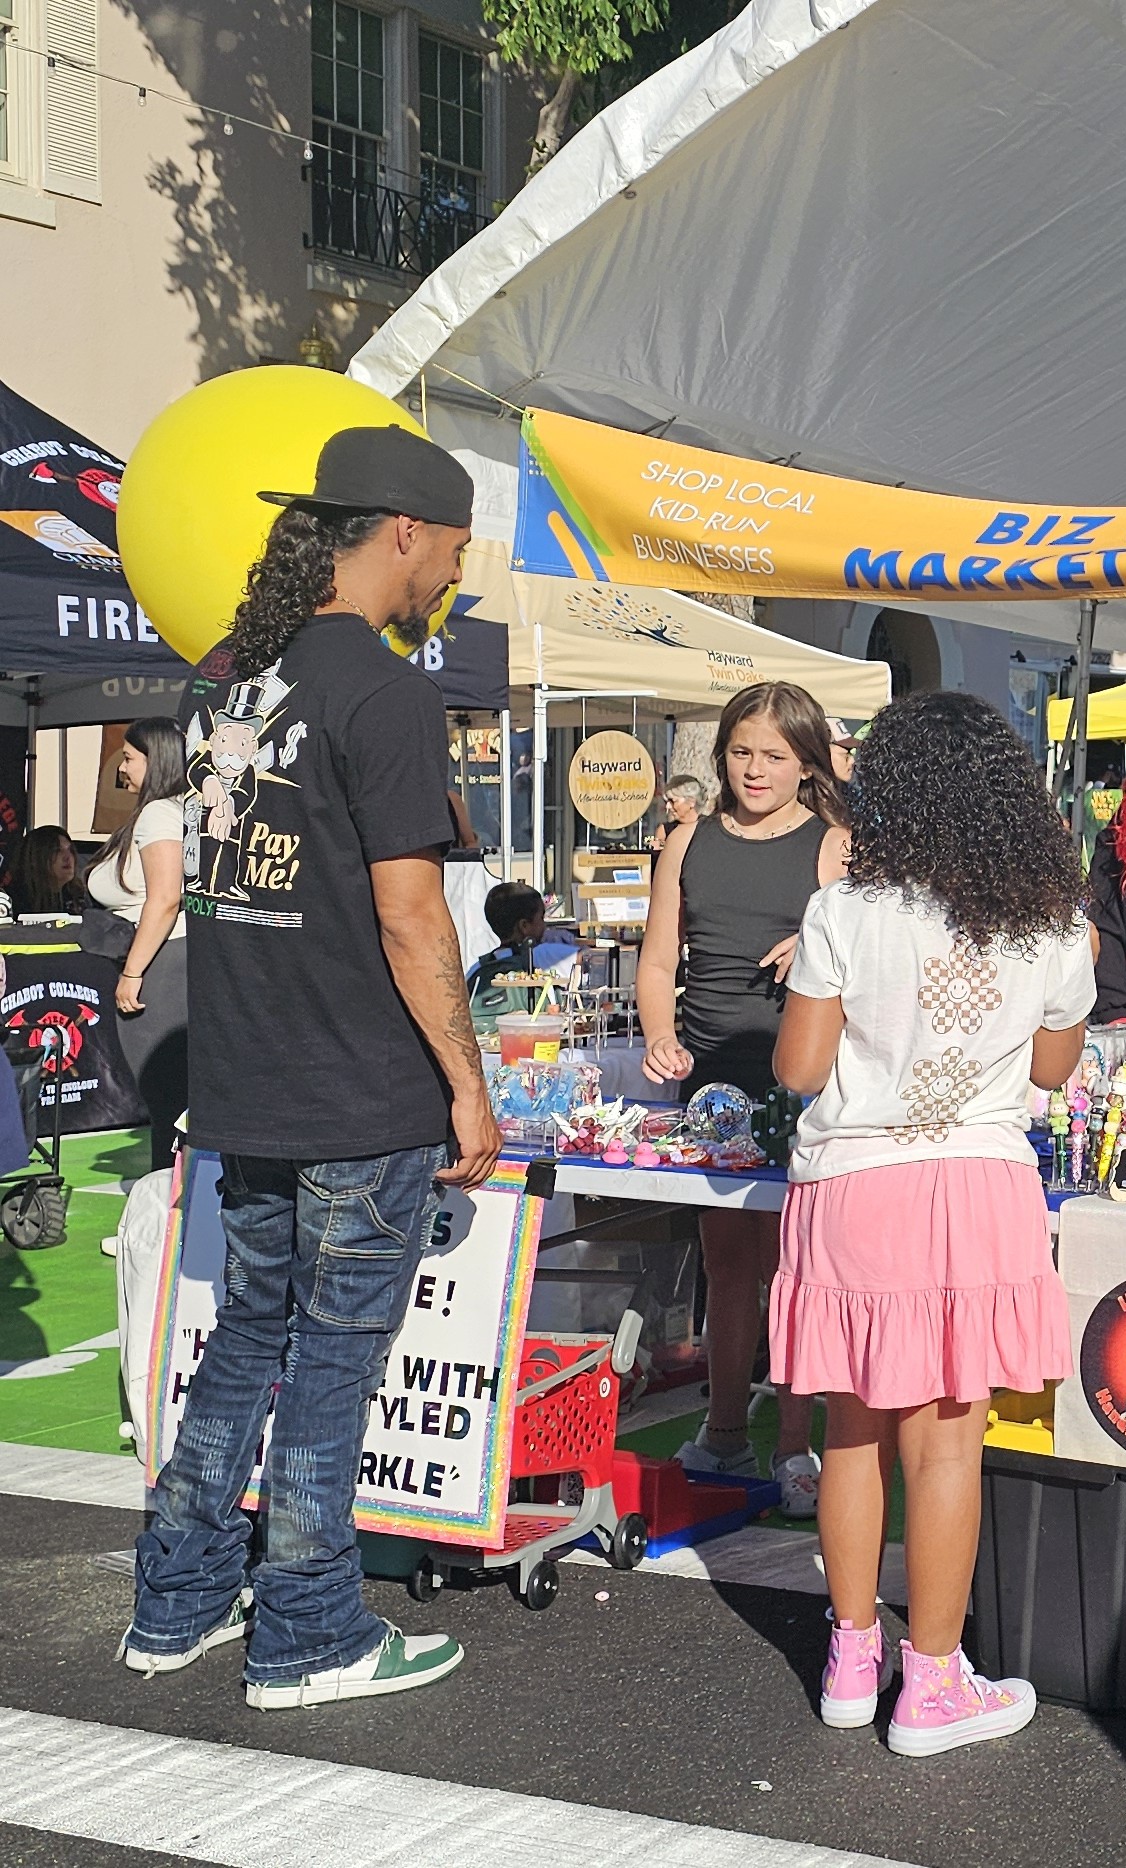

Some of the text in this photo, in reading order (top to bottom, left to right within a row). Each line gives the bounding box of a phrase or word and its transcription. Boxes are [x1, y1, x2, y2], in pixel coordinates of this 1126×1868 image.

[0, 440, 69, 467] CHABOT
[641, 460, 816, 515] SHOP LOCAL
[650, 496, 771, 535] KID-RUN
[974, 511, 1115, 546] BIZ
[632, 533, 775, 576] BUSINESSES
[57, 594, 159, 643] FIRE
[706, 650, 754, 668] Hayward
[707, 665, 765, 683] Twin Oaks
[577, 776, 648, 790] Twin Oaks
[581, 758, 642, 775] Hayward
[621, 791, 649, 802] School
[246, 821, 301, 865] Pay
[242, 855, 300, 891] Me!
[185, 895, 217, 917] POLY
[1, 982, 100, 1014] CHABOT COLLEGE
[403, 1354, 501, 1402] WITH
[369, 1392, 471, 1440] YLED
[357, 1451, 460, 1498] RKLE"
